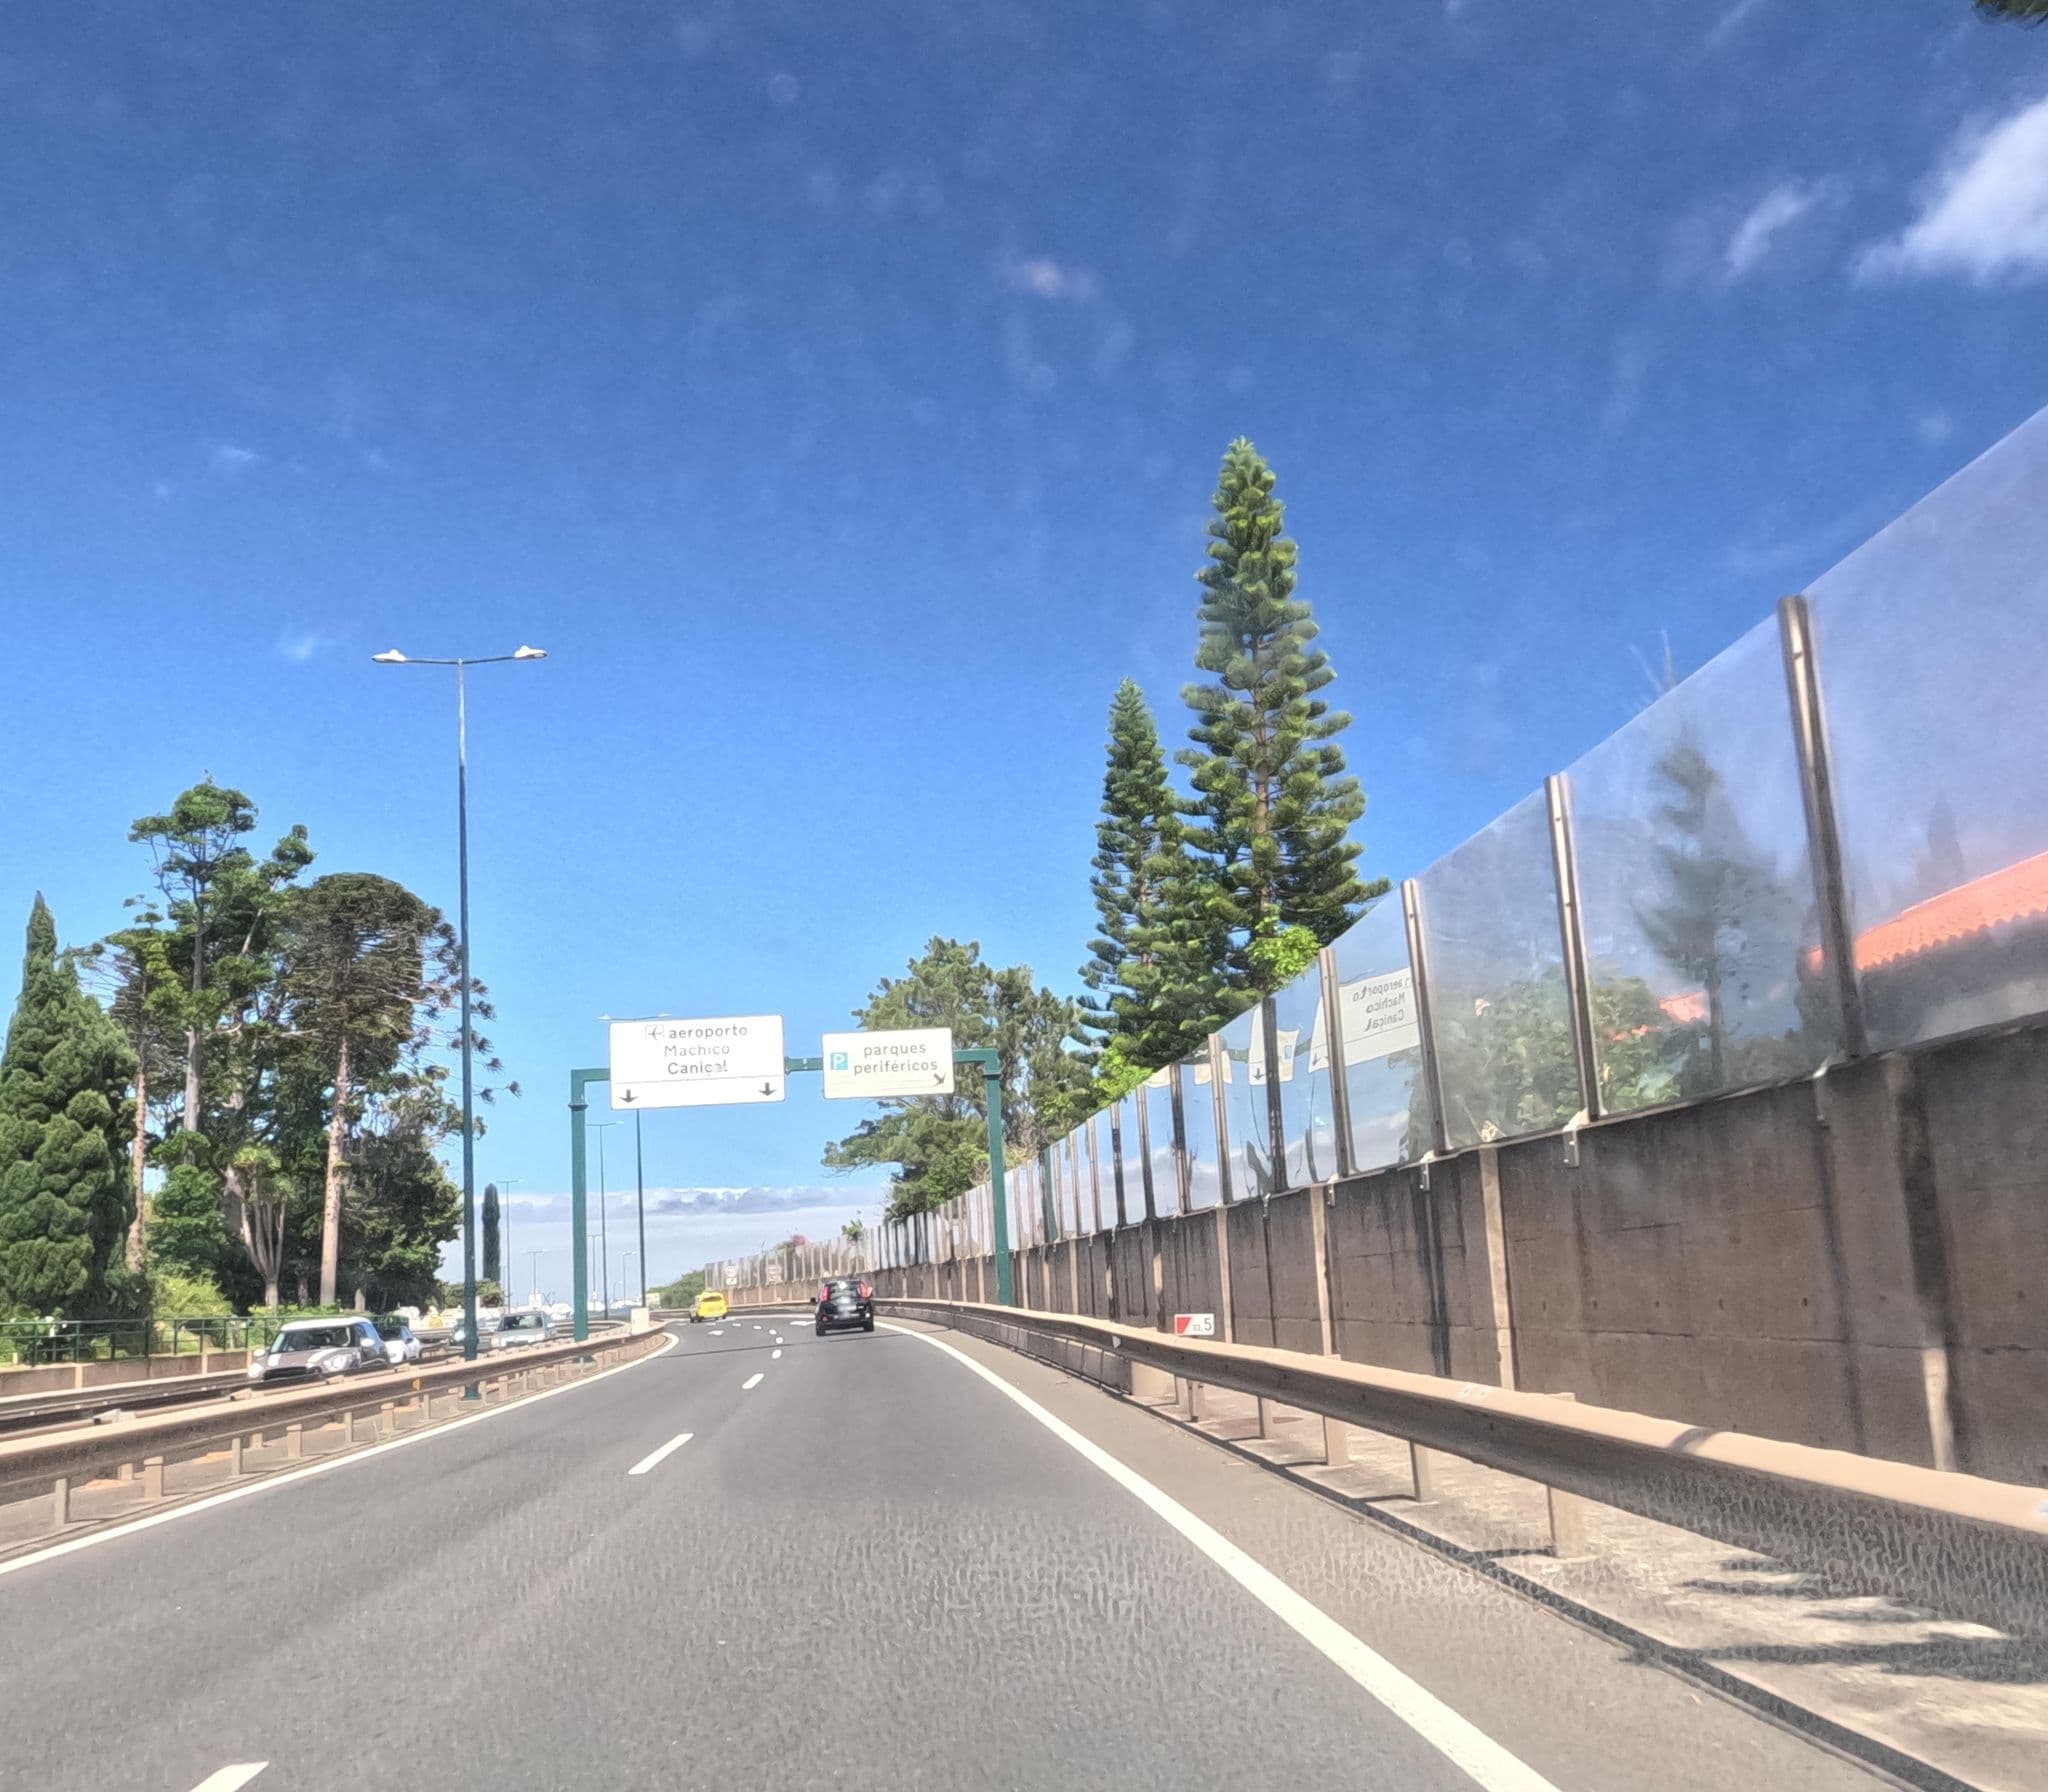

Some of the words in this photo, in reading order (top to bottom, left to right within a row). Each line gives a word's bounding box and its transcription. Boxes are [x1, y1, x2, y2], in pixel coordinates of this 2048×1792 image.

[669, 1024, 747, 1040] aeroporto
[664, 1044, 730, 1057] Machico
[864, 1044, 927, 1057] parques
[833, 1053, 846, 1070] P
[854, 1059, 938, 1076] periféricos
